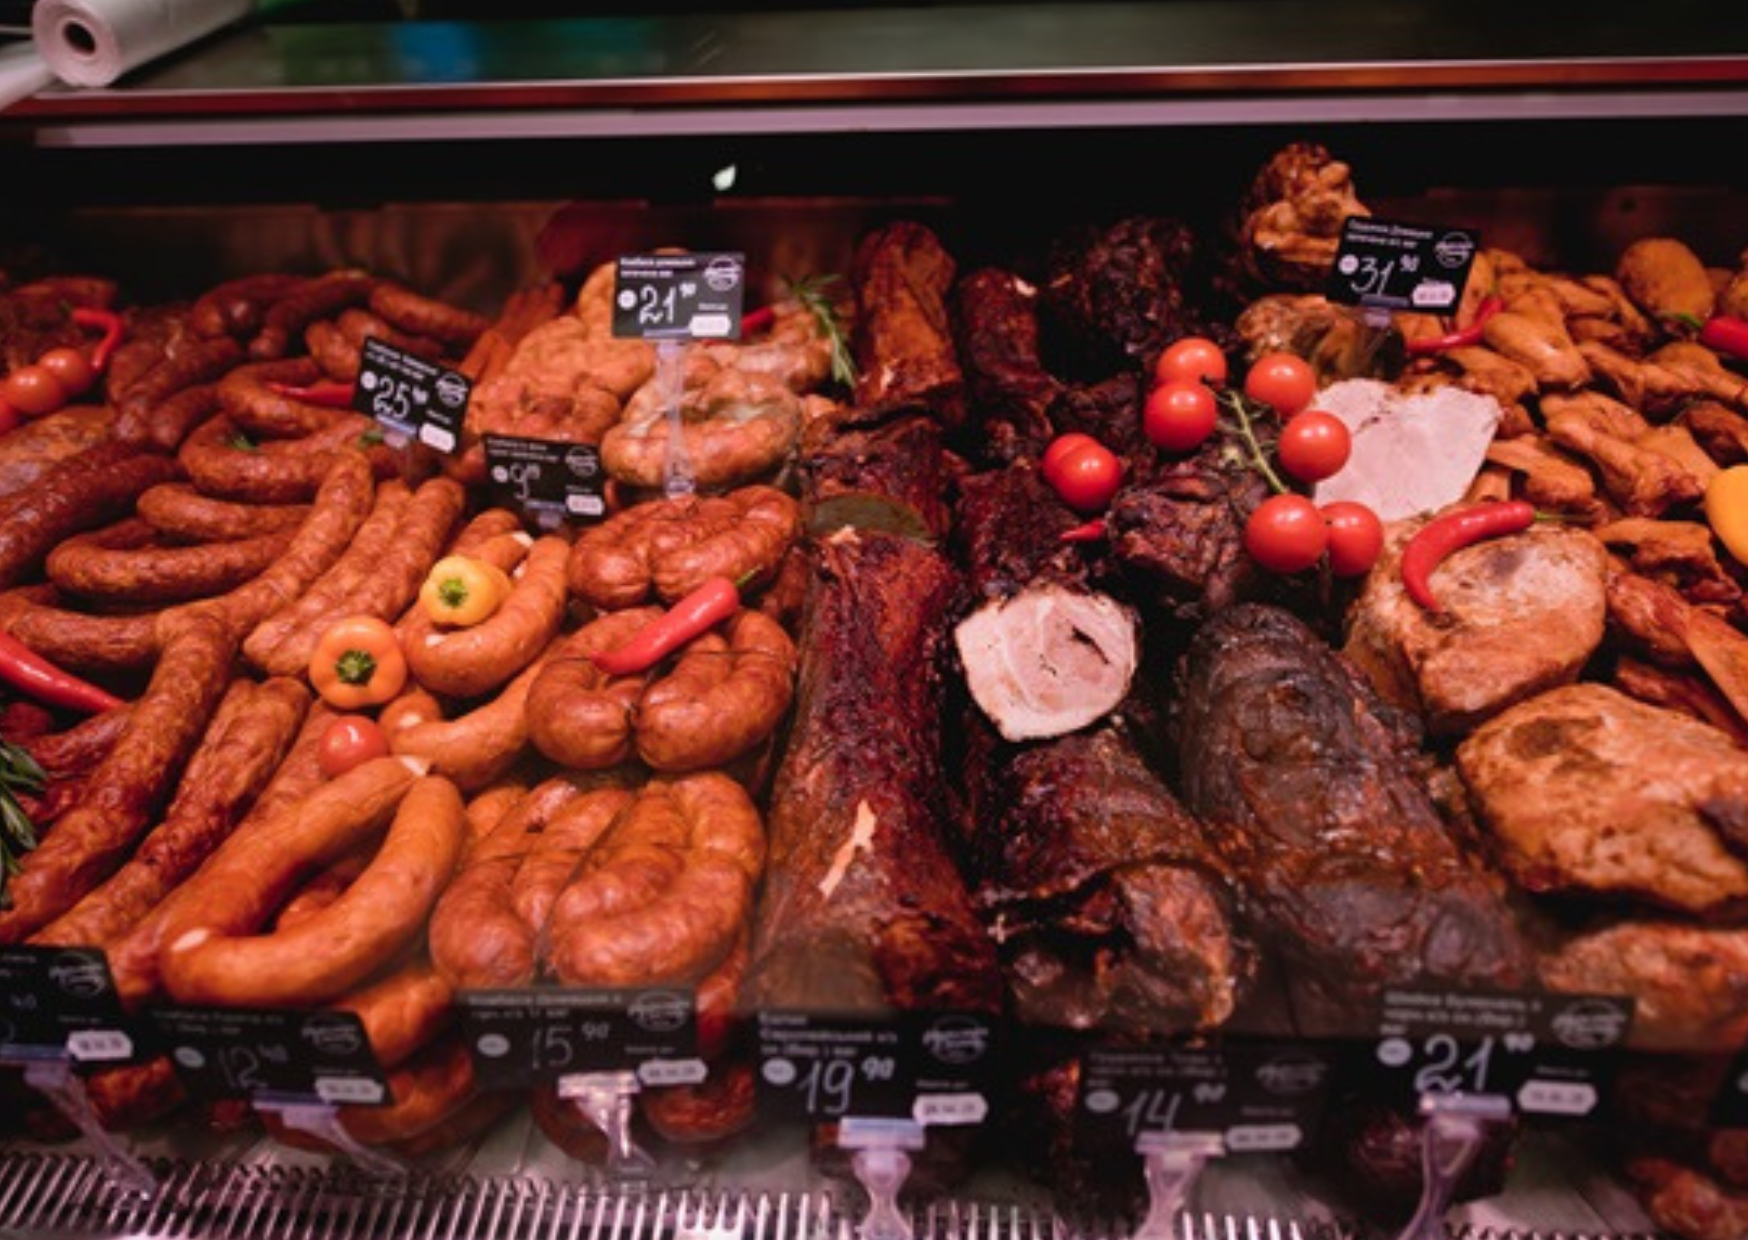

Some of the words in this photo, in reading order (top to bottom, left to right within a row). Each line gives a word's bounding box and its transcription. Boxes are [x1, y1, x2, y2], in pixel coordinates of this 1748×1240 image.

[1351, 257, 1395, 295] 31
[639, 284, 676, 324] 21
[374, 376, 411, 420] 25
[532, 1026, 573, 1070] 15
[1414, 1034, 1494, 1092] 21
[797, 1059, 856, 1114] 19
[1120, 1089, 1182, 1137] 14
